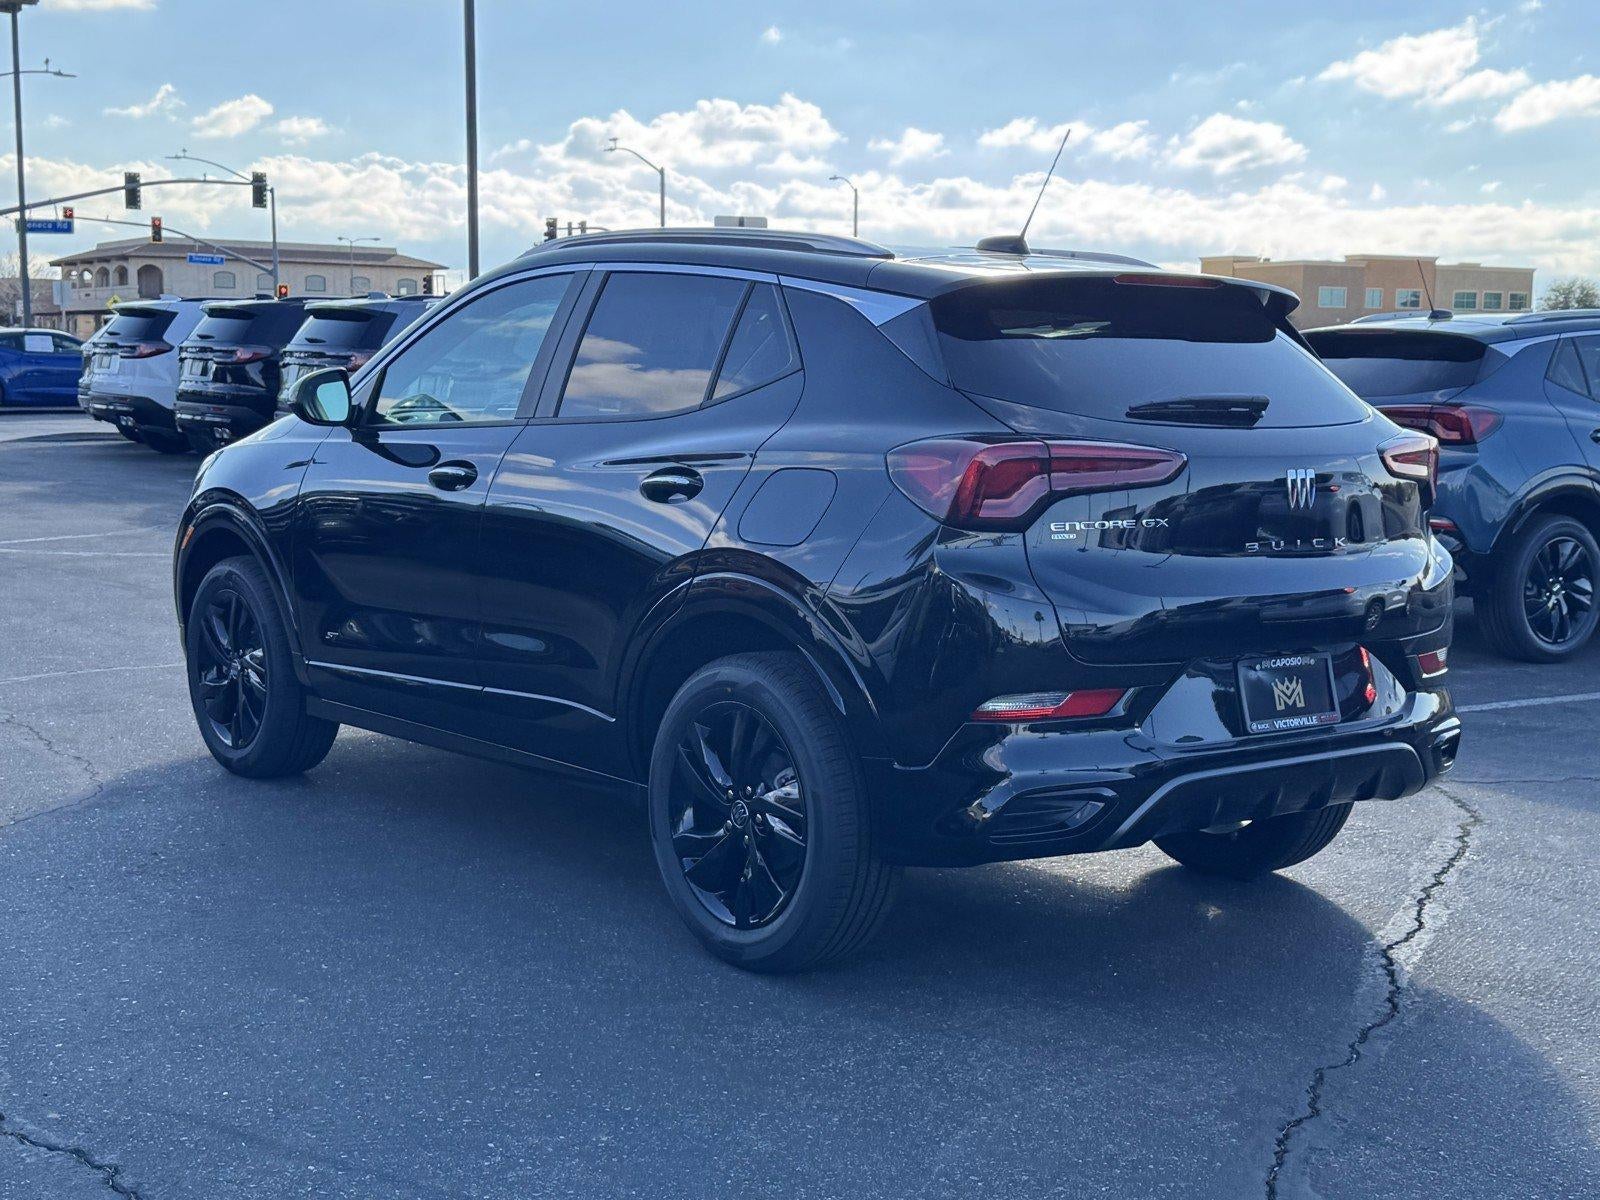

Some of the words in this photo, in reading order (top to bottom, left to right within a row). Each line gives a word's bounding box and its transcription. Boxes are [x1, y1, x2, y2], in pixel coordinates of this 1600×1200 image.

[1050, 519, 1136, 532] ENCORE
[1141, 518, 1169, 528] GX
[1245, 537, 1347, 553] BUICK
[1270, 657, 1302, 668] CAPOSIO
[1273, 716, 1319, 729] VICTORVILLE
